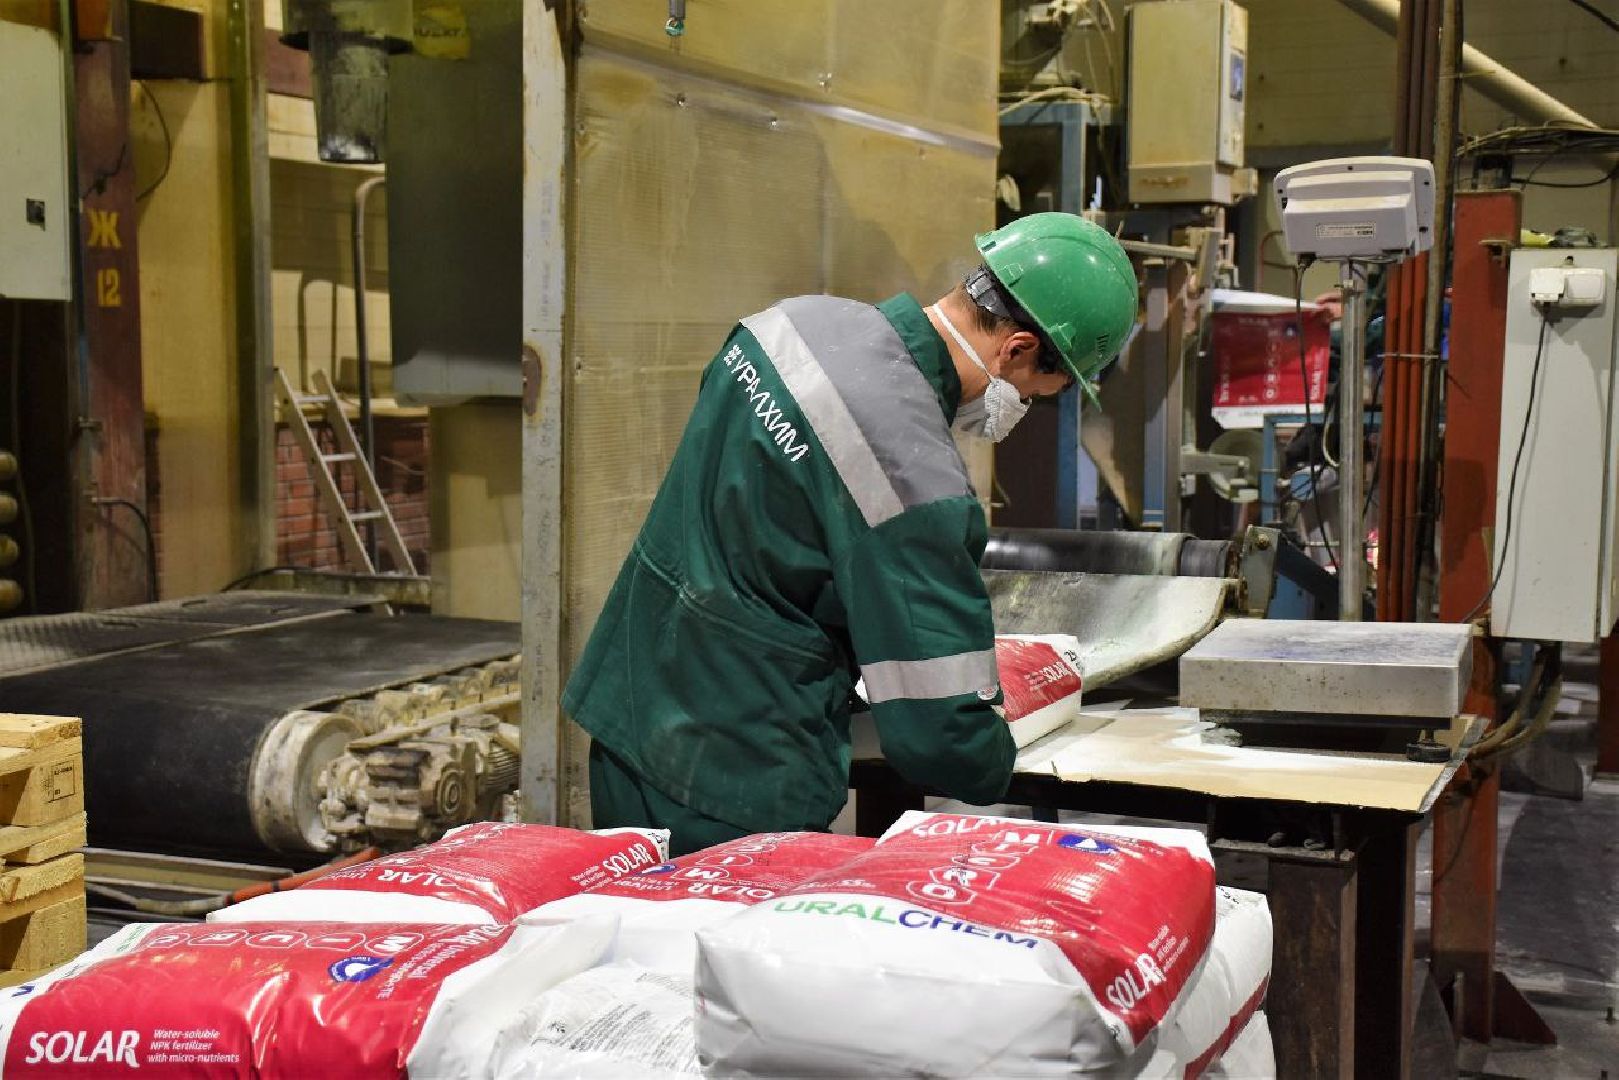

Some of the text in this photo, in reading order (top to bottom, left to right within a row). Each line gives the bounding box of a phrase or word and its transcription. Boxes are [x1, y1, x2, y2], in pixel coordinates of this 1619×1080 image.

[87, 208, 122, 249] Ж
[97, 269, 121, 307] 12
[911, 816, 1001, 839] SOLA
[602, 842, 657, 878] SOLAR
[687, 881, 775, 898] OLAR
[773, 900, 1049, 949] URALCHEM
[1105, 952, 1167, 1015] SOLAR
[25, 1030, 141, 1068] SOLAR
[150, 1040, 213, 1051] NPK fertilizer
[153, 1029, 221, 1039] Water-soluble
[148, 1052, 240, 1063] with micro-nutrients
